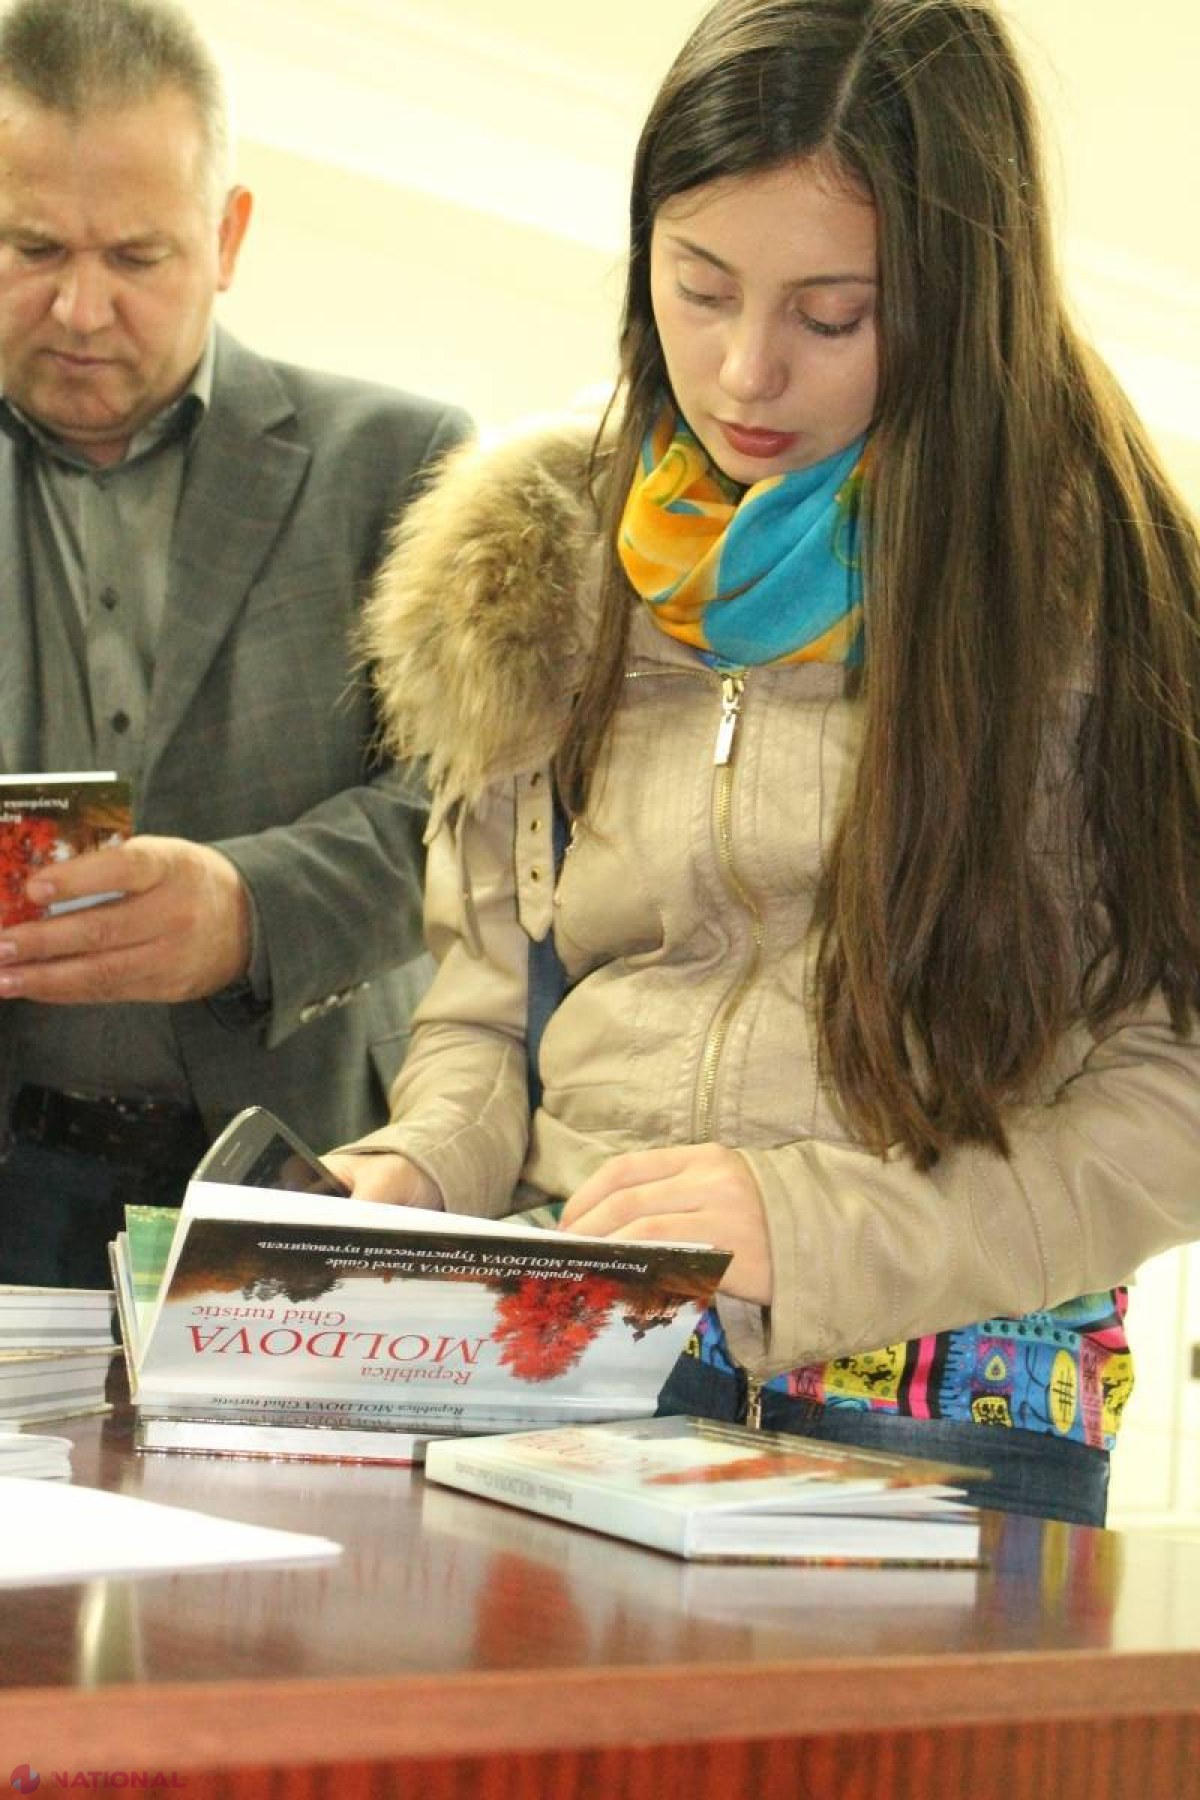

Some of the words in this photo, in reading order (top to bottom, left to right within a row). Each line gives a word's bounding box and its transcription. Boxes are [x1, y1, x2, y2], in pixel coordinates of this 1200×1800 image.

[257, 1241, 360, 1255] путеводитель
[363, 1247, 476, 1262] Туристический
[325, 1258, 369, 1269] Guide
[371, 1260, 414, 1272] Travel
[482, 1254, 564, 1268] MOLDOVA
[567, 1259, 648, 1273] Республика
[420, 1263, 503, 1276] MOLDOVA
[502, 1268, 521, 1278] of
[523, 1269, 585, 1282] Republic
[191, 1305, 275, 1324] turistic
[283, 1308, 346, 1327] Ghid
[185, 1325, 489, 1365] MOLDOVA
[361, 1366, 472, 1386] Republica
[304, 1401, 394, 1413] MOLDOVA
